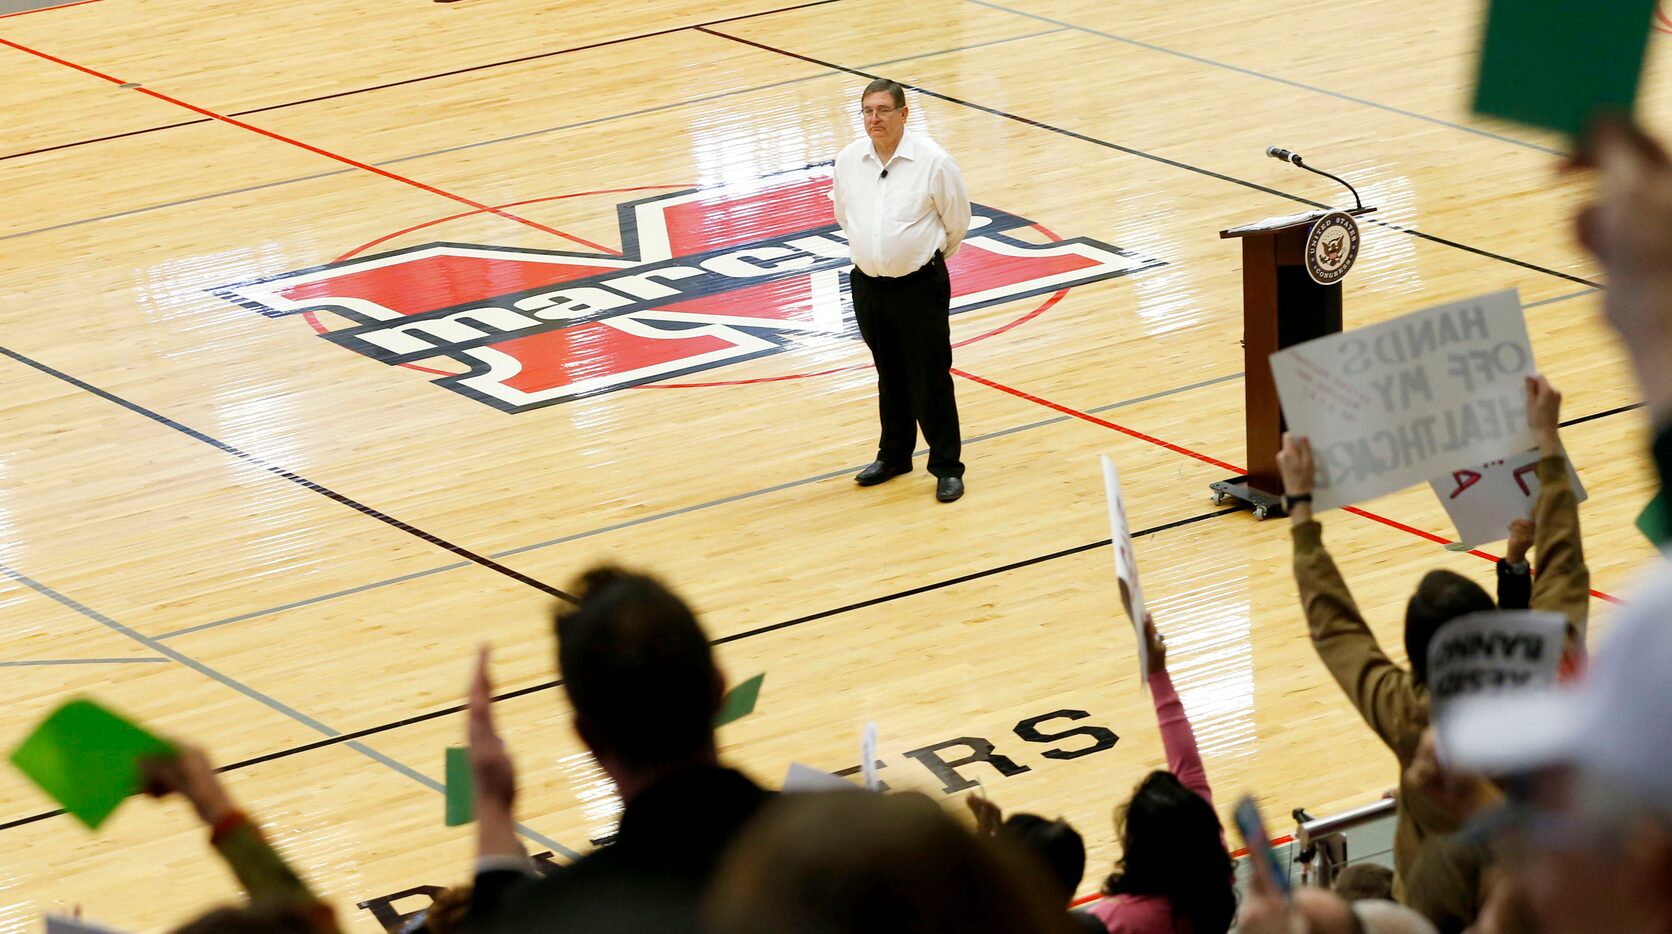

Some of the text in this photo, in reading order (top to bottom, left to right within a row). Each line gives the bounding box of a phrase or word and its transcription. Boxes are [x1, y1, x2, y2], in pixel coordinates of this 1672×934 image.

[1310, 217, 1357, 254] UNITED STATES
[365, 215, 993, 354] marc
[1315, 259, 1351, 279] CONGRESS
